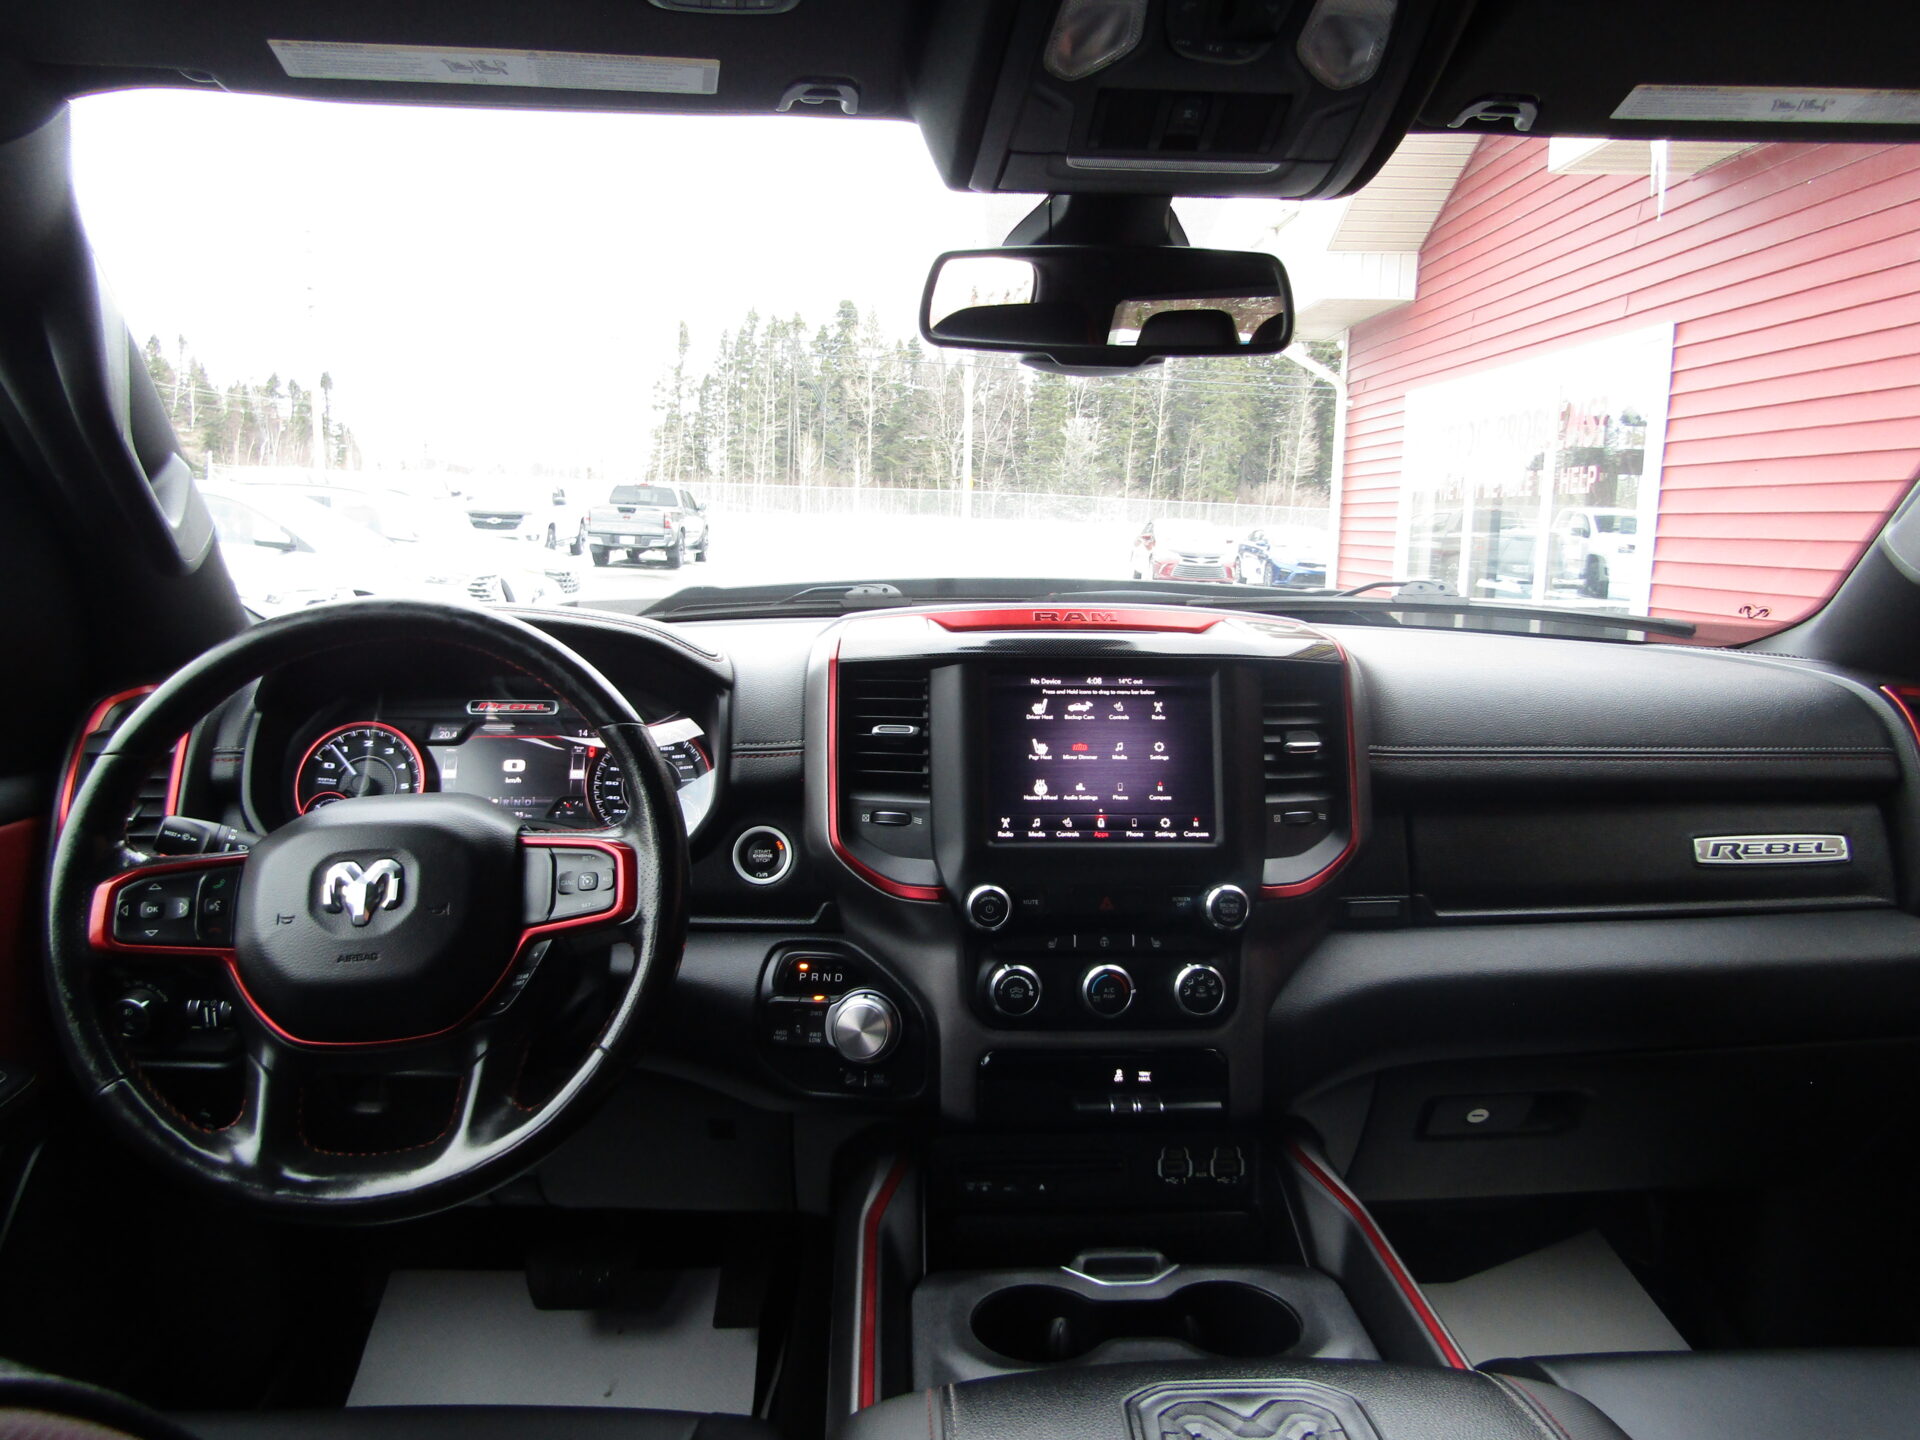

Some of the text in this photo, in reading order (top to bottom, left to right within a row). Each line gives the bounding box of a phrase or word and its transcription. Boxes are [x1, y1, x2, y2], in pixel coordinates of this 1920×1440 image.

[1559, 464, 1598, 495] HELP
[1033, 611, 1118, 622] RAM
[1030, 677, 1062, 685] No Device
[1086, 676, 1103, 685] 4:08
[578, 729, 588, 737] 14
[363, 739, 374, 747] 2
[502, 759, 526, 773] 0
[997, 830, 1014, 838] Radio
[1027, 830, 1046, 838] Media
[1056, 830, 1080, 838] Controls
[1093, 830, 1109, 839] Apps
[1125, 830, 1144, 838] Phone
[1154, 830, 1177, 839] Settings
[1183, 830, 1210, 838] Compass
[1706, 839, 1839, 861] REBEL
[146, 905, 159, 913] OK
[799, 972, 844, 982] P R N D
